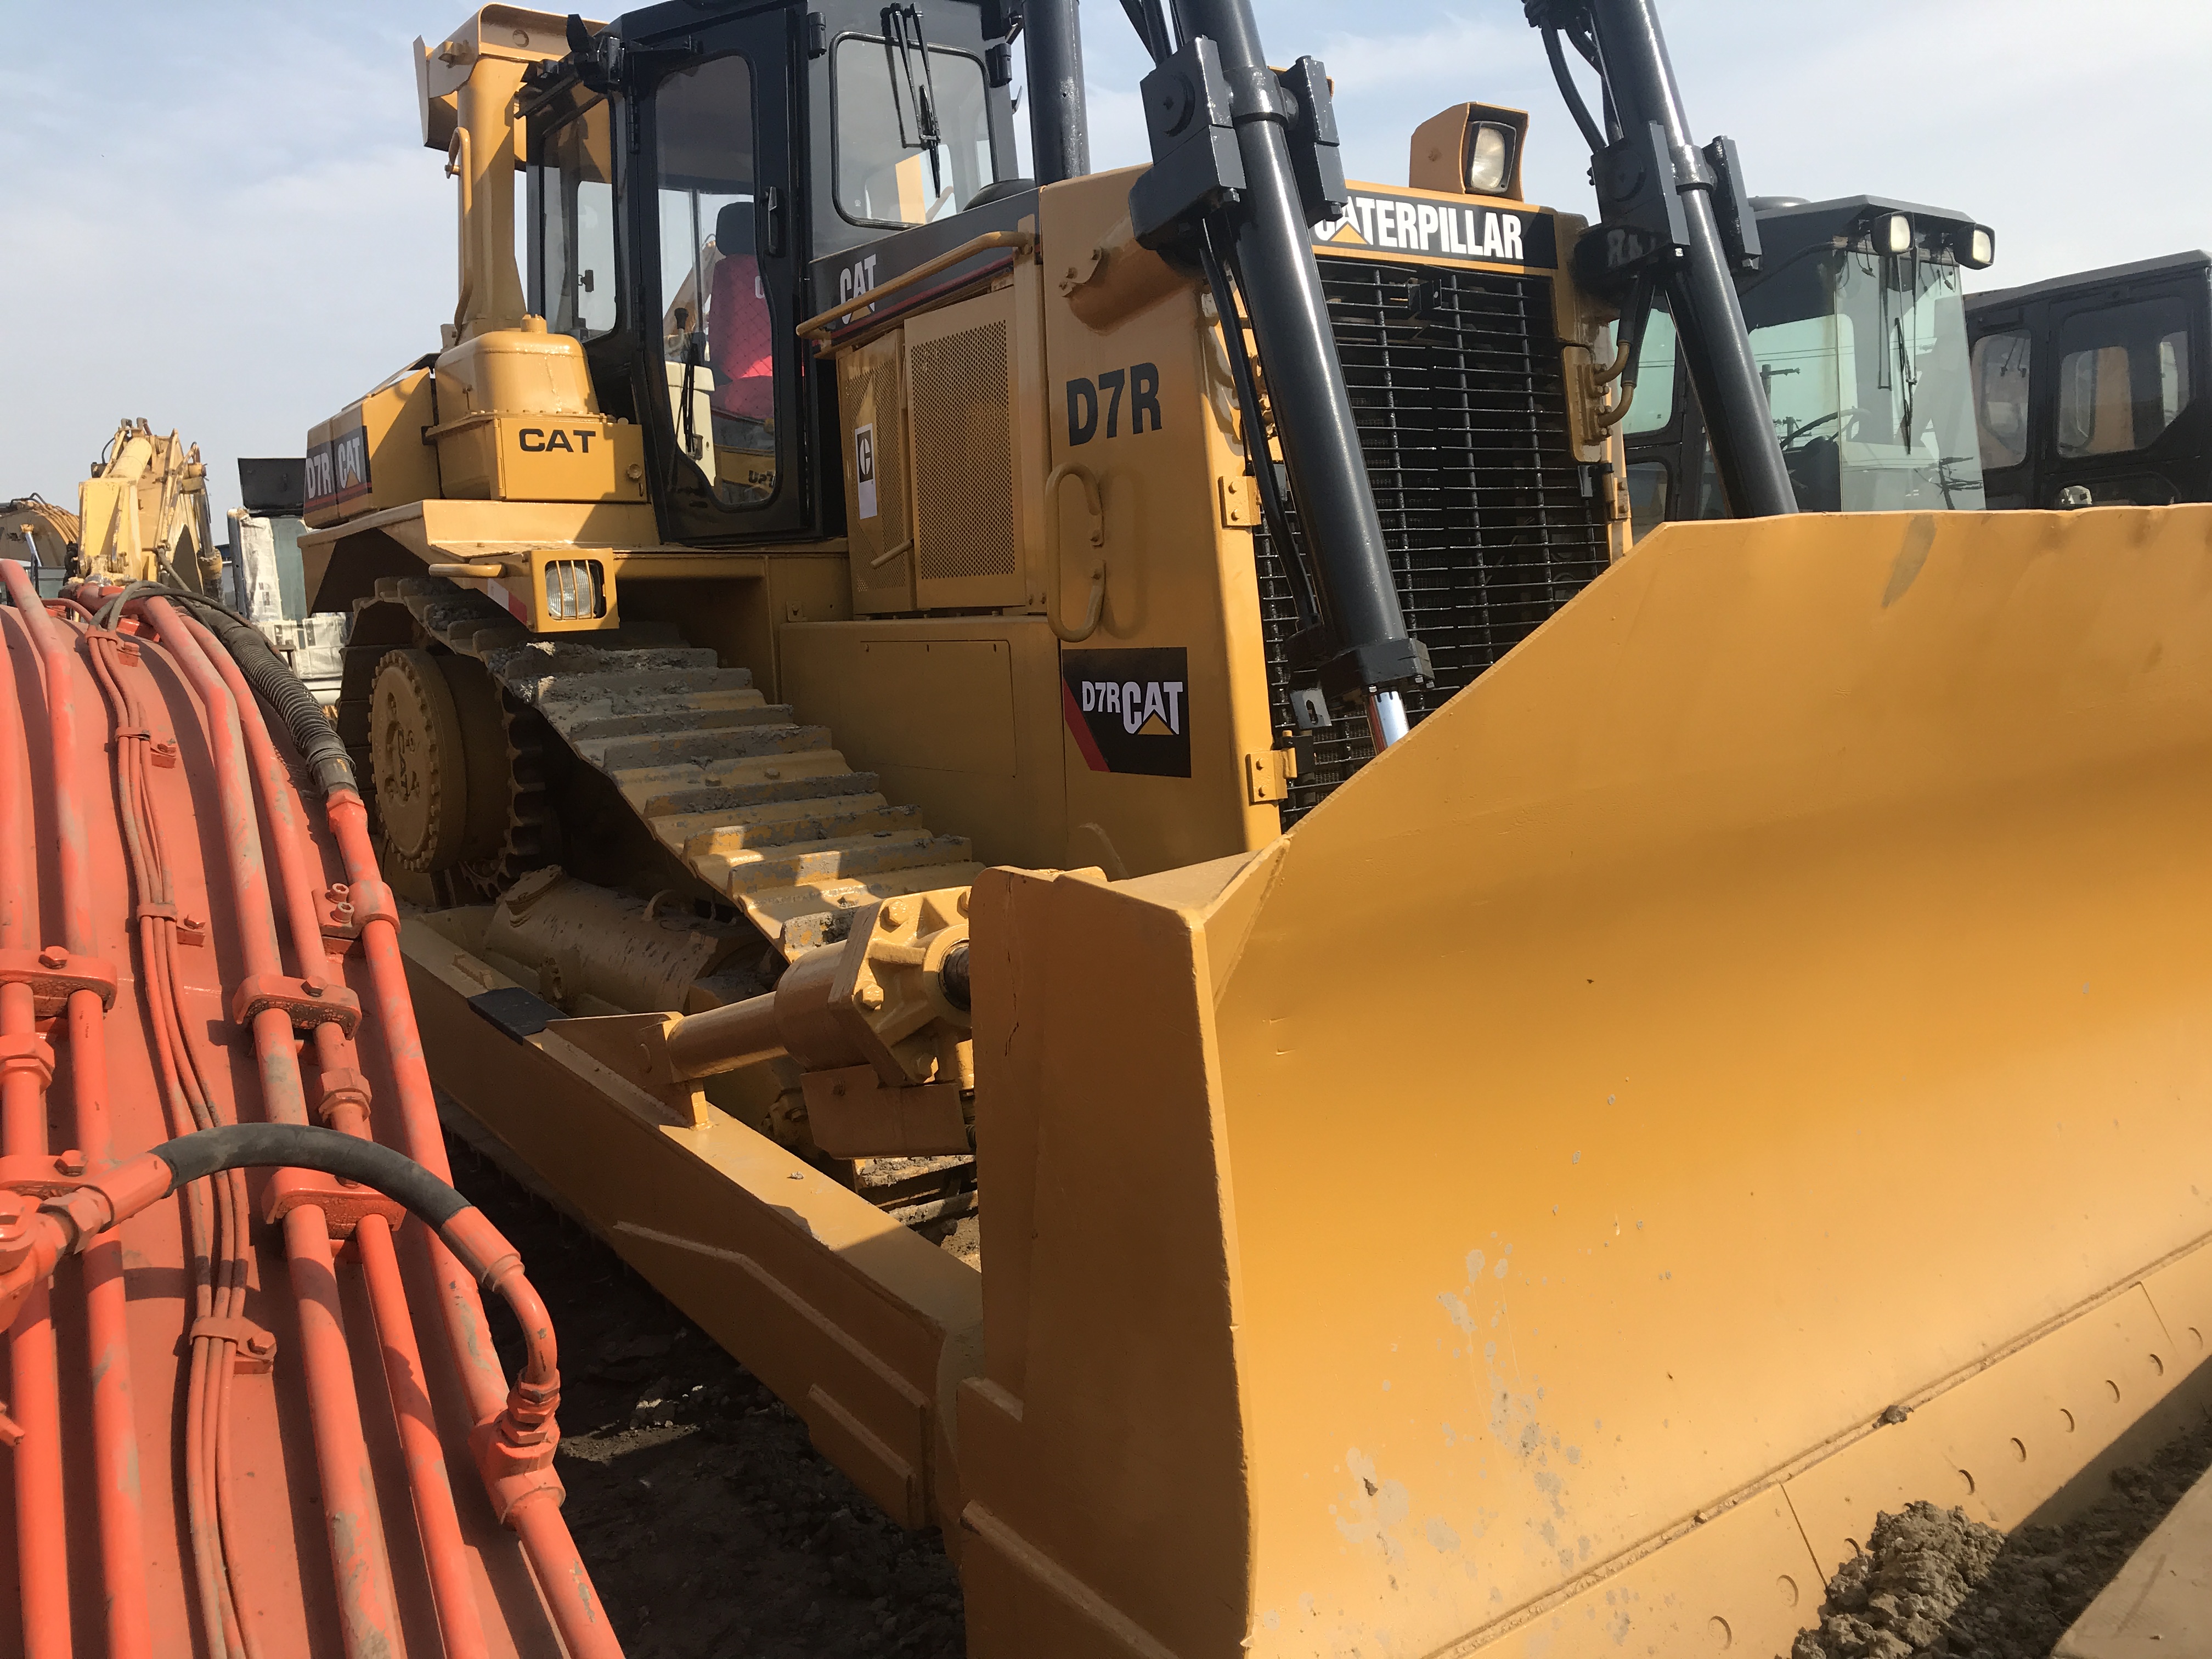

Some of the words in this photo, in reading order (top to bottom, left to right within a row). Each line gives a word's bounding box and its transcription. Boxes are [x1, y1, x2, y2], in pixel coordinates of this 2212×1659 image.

[840, 253, 877, 325] CAT
[1066, 362, 1163, 447] D7R
[306, 452, 332, 499] D7R
[338, 437, 361, 489] CAT
[519, 428, 596, 453] CAT
[1082, 681, 1121, 713] D7R
[1122, 681, 1183, 735] CAT
